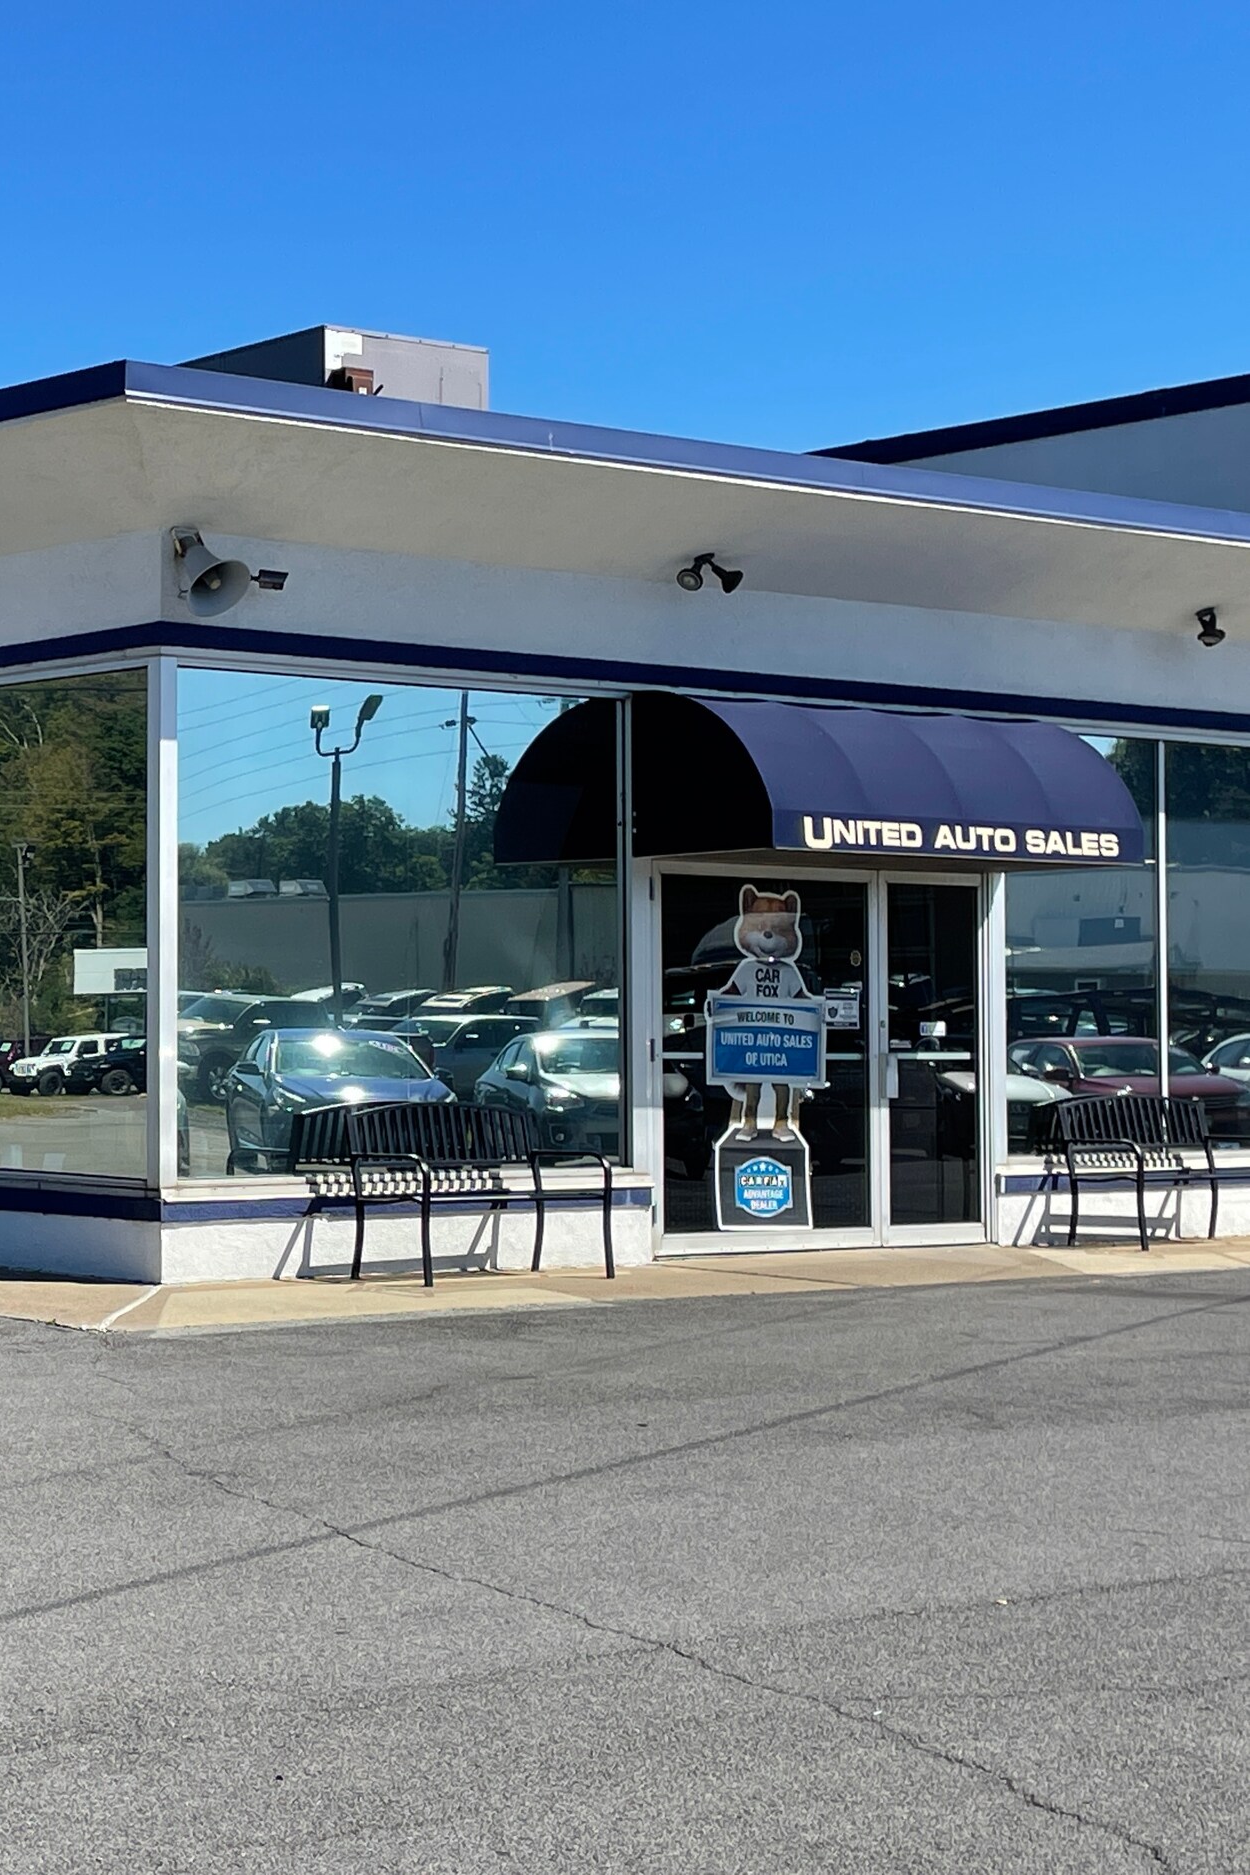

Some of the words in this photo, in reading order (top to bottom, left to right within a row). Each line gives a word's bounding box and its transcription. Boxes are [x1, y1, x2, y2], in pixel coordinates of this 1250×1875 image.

[803, 816, 922, 849] UNITED
[934, 824, 1017, 852] AUTO
[1025, 829, 1120, 858] SALES
[755, 968, 781, 983] CAR
[756, 984, 779, 998] FOX
[737, 1010, 780, 1024] WELCOME
[783, 1013, 795, 1025] TO
[720, 1031, 755, 1046] UNITED
[756, 1032, 781, 1048] AUTO
[783, 1034, 813, 1049] SALES
[745, 1051, 758, 1066] OF
[760, 1052, 788, 1067] UTICA
[739, 1174, 788, 1187] CARFAX
[743, 1189, 784, 1200] ADVANTAGE
[750, 1199, 778, 1210] DEALER
